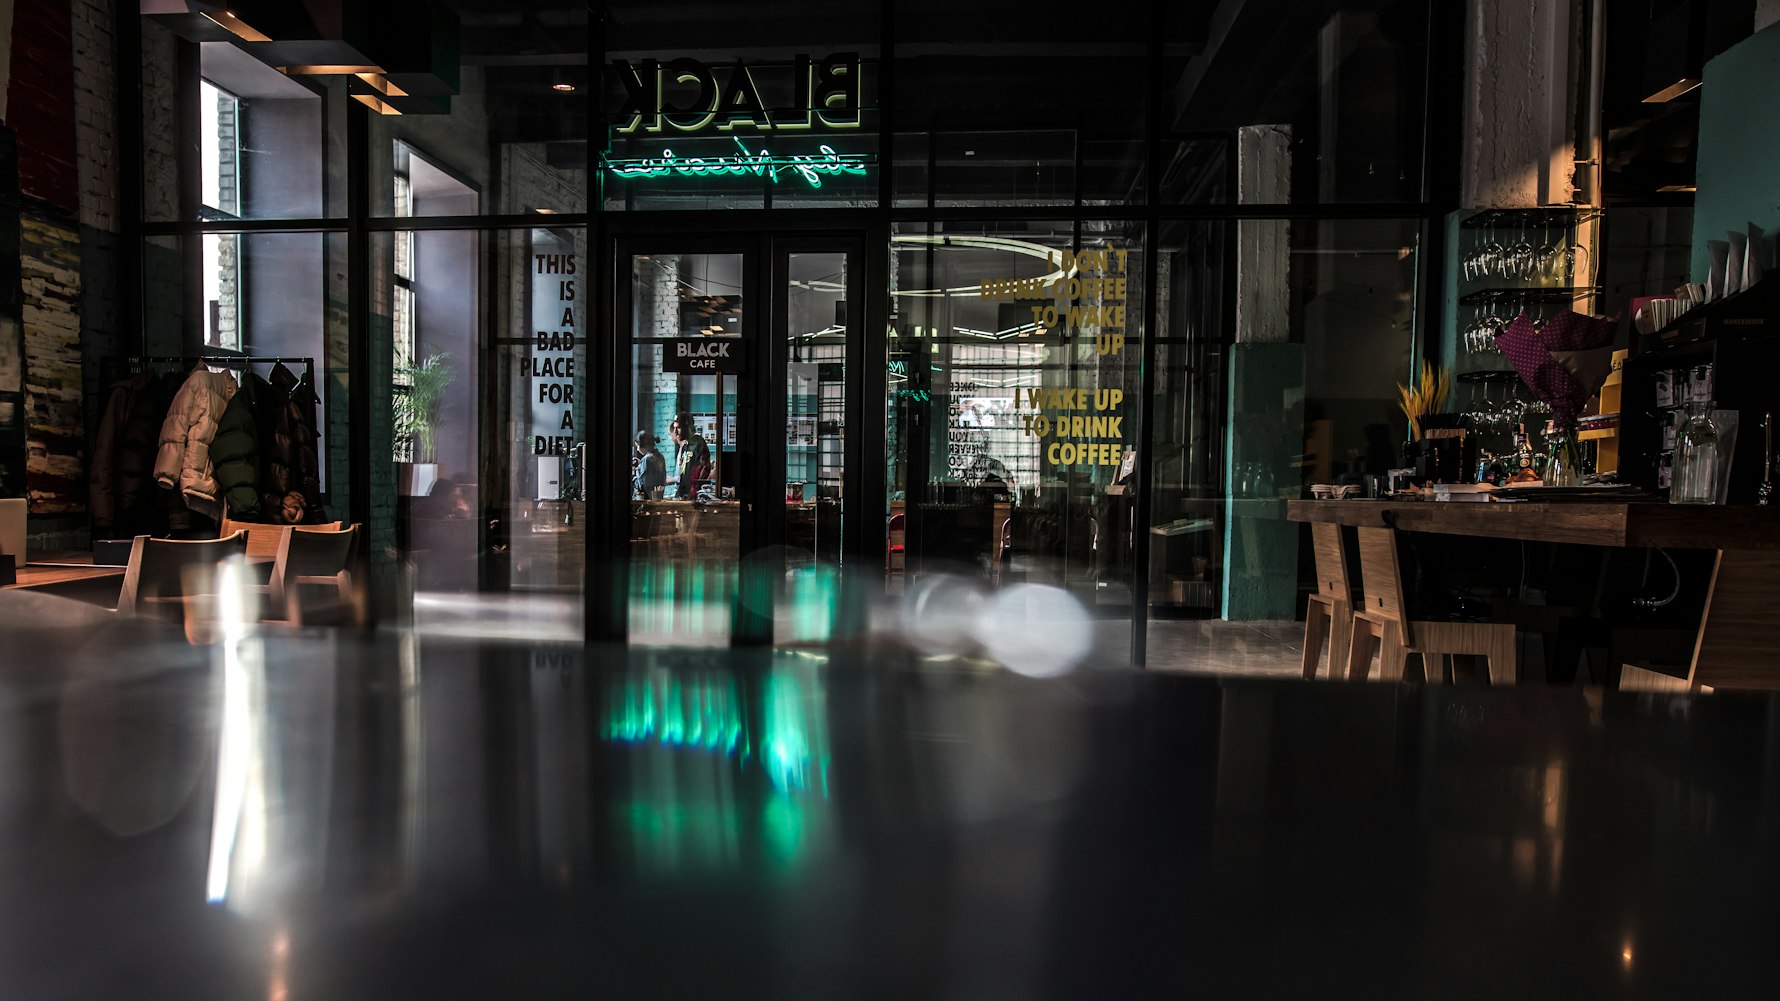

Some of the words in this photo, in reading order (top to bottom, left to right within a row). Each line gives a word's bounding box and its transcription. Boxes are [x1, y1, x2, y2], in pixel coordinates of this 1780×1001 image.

[536, 254, 576, 275] THIS
[1047, 251, 1054, 273] I
[559, 281, 575, 301] IS
[980, 279, 1048, 301] DRINK
[1052, 278, 1126, 300] COFFEE
[561, 307, 575, 327] A
[1031, 306, 1059, 328] TO
[1064, 305, 1125, 328] WAKE
[537, 331, 575, 352] BAD
[676, 342, 730, 358] BLACK
[1096, 334, 1125, 356] UP
[520, 358, 575, 377] PLACE
[689, 359, 716, 369] CAFE
[539, 383, 574, 404] FOR
[1014, 389, 1021, 409] I
[1027, 388, 1087, 410] WAKE
[1094, 388, 1124, 411] UP
[560, 410, 574, 430] A
[1022, 416, 1050, 438] TO
[1056, 416, 1123, 438] DRINK
[535, 435, 573, 456] DIET
[1047, 443, 1122, 466] COFFEE
